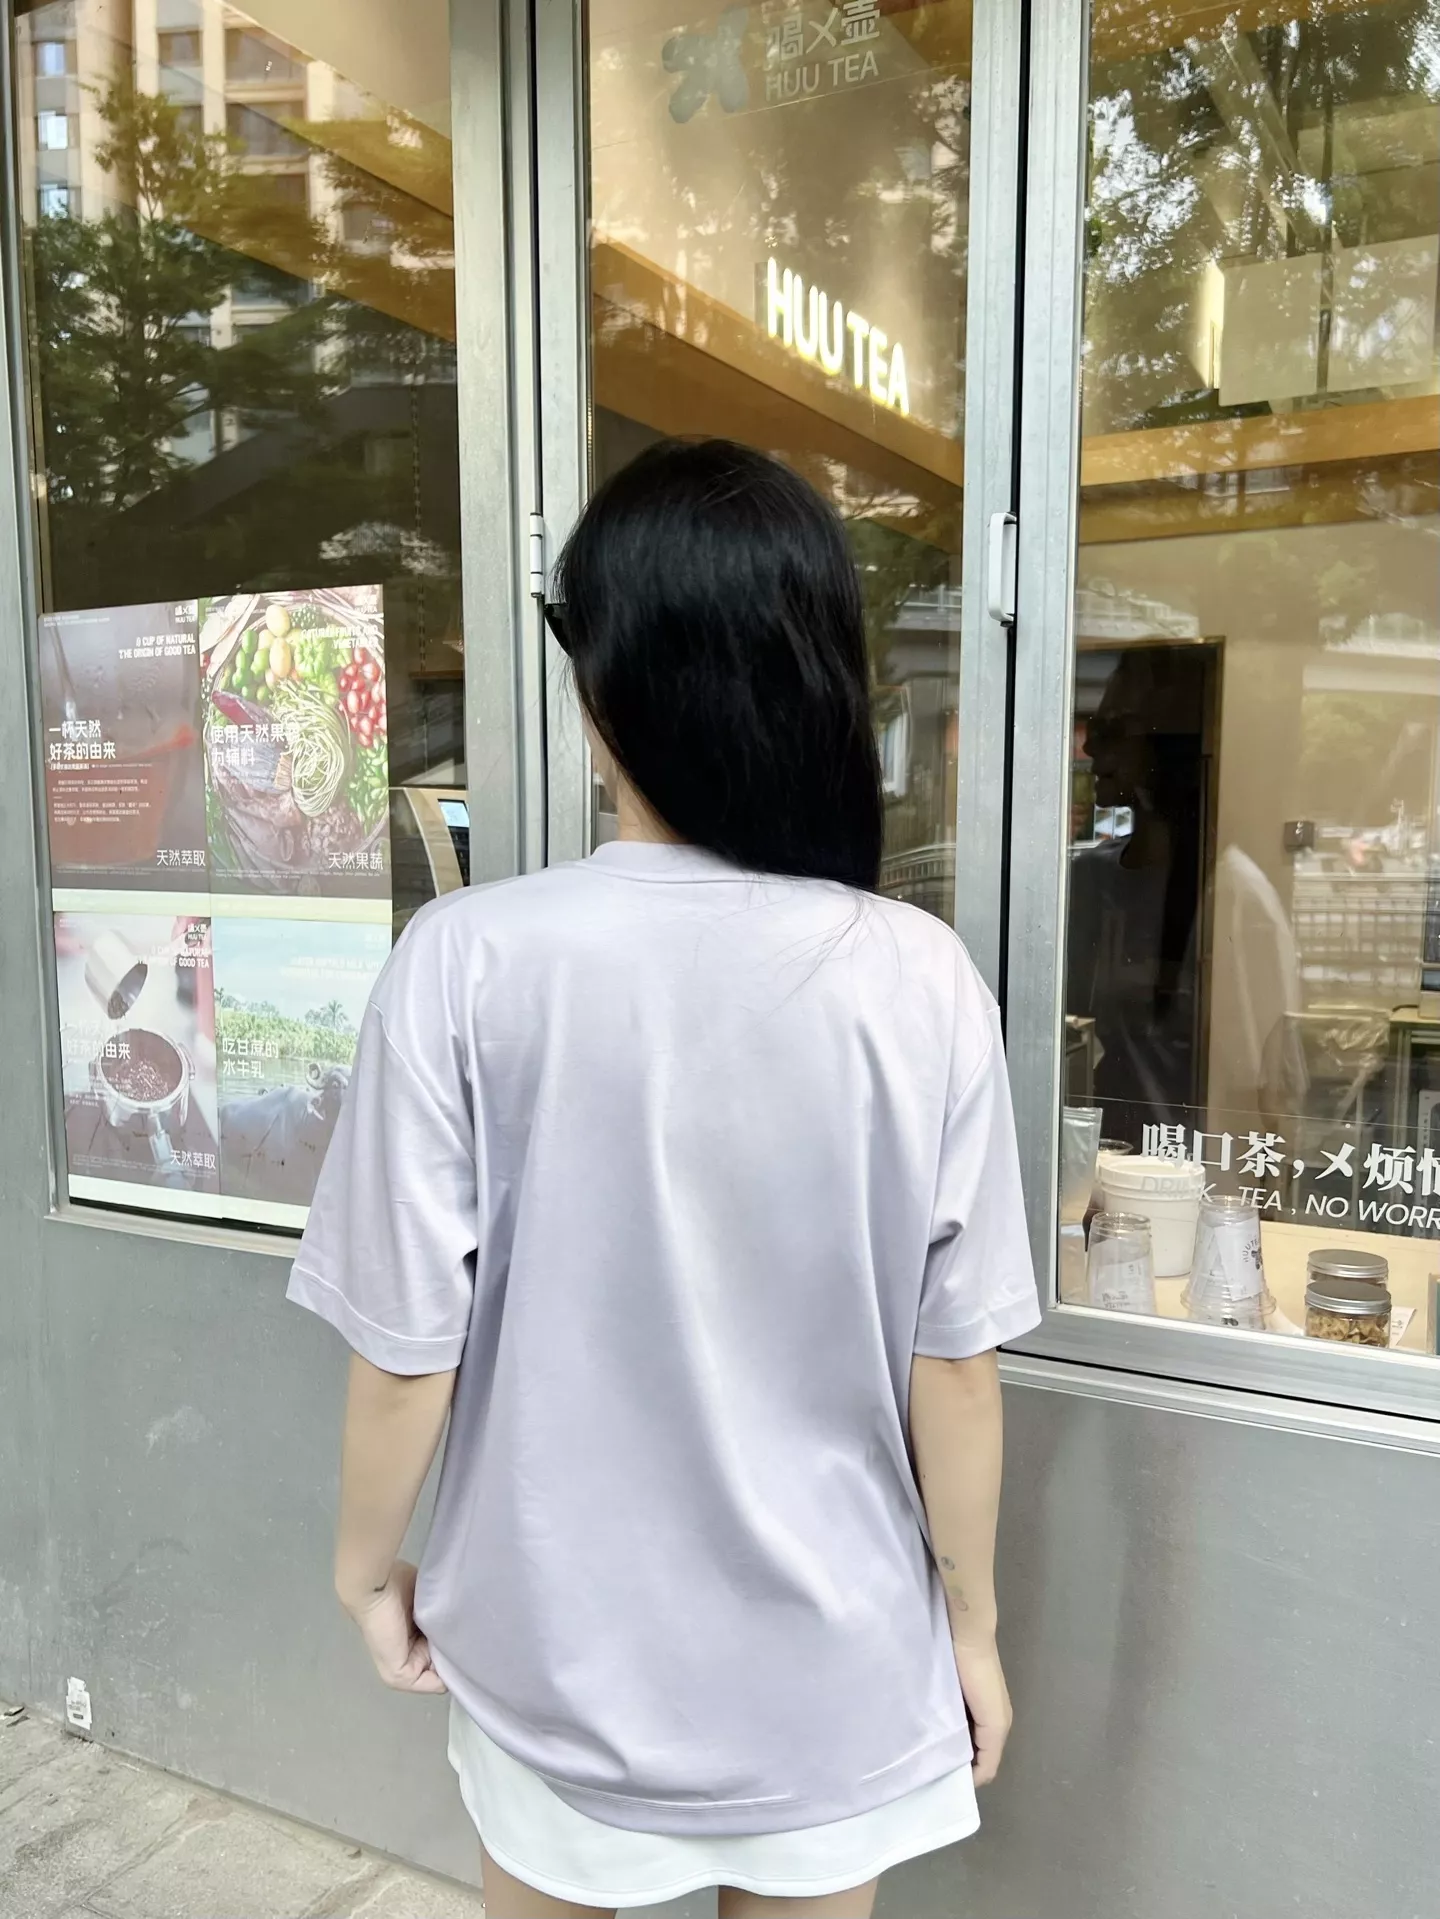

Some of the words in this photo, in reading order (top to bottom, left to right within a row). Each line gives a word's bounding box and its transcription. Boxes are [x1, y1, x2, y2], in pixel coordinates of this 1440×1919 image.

[765, 63, 820, 101] HUU
[828, 50, 879, 86] TEA
[166, 633, 195, 645] NATURAL
[183, 644, 196, 655] TEA
[48, 719, 101, 739] 一杯天然
[49, 740, 116, 760] 好茶的由来
[156, 849, 206, 867] 天然萃取
[328, 851, 384, 870] 天然果蔬
[196, 958, 210, 969] TEA
[222, 1058, 265, 1079] 水牛乳
[170, 1149, 216, 1170] 天然萃取
[1305, 1194, 1350, 1218] NO
